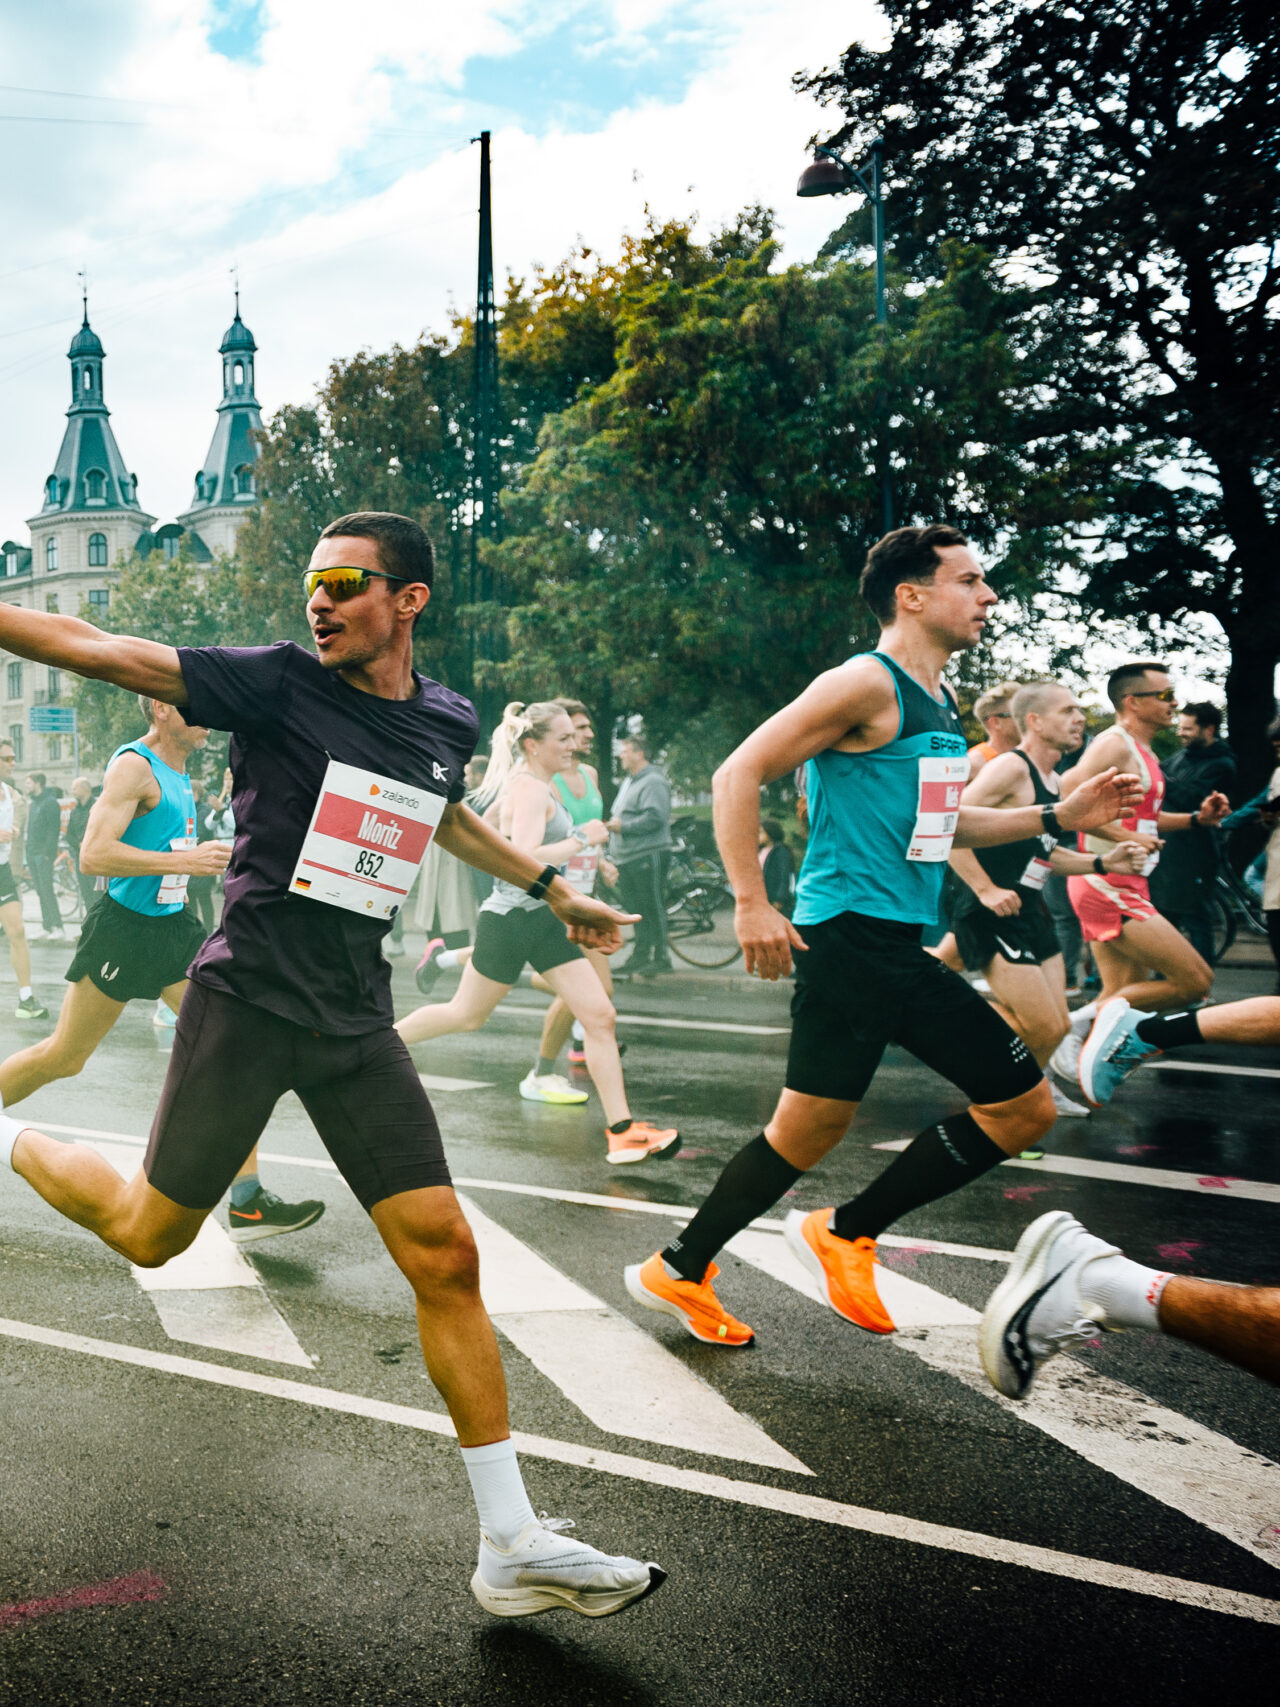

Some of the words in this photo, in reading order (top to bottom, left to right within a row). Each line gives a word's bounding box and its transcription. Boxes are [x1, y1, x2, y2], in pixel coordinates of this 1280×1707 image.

[381, 789, 420, 810] zalando
[357, 810, 404, 850] Moritz
[354, 850, 384, 879] 852
